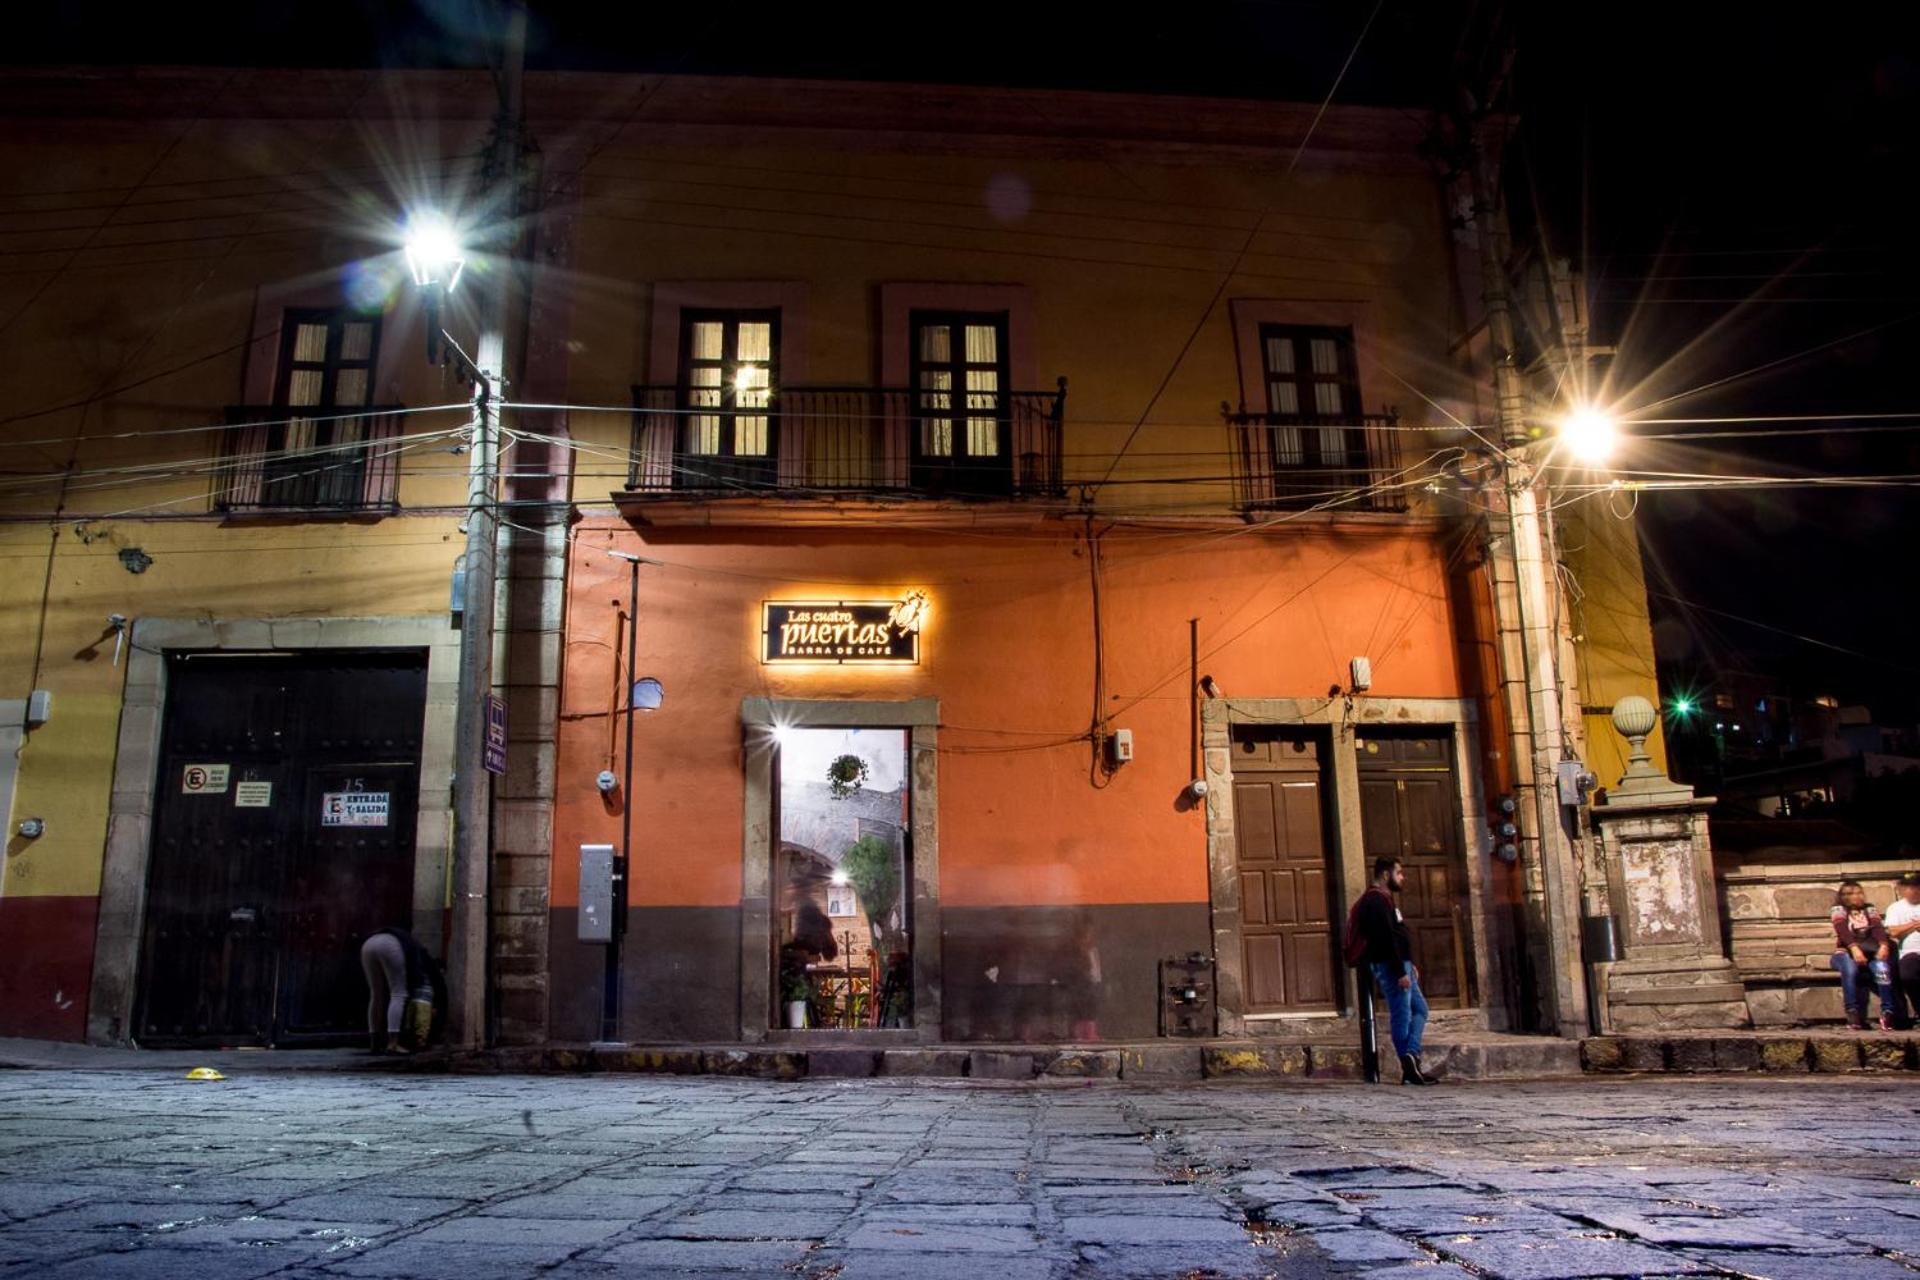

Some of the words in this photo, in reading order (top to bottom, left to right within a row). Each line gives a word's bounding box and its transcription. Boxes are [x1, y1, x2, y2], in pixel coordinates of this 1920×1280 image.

[788, 610, 811, 622] Las
[812, 611, 852, 623] cuatro
[781, 621, 890, 655] puertas
[344, 778, 364, 793] 15
[347, 794, 387, 804] ENTRADA
[324, 815, 341, 824] LAS
